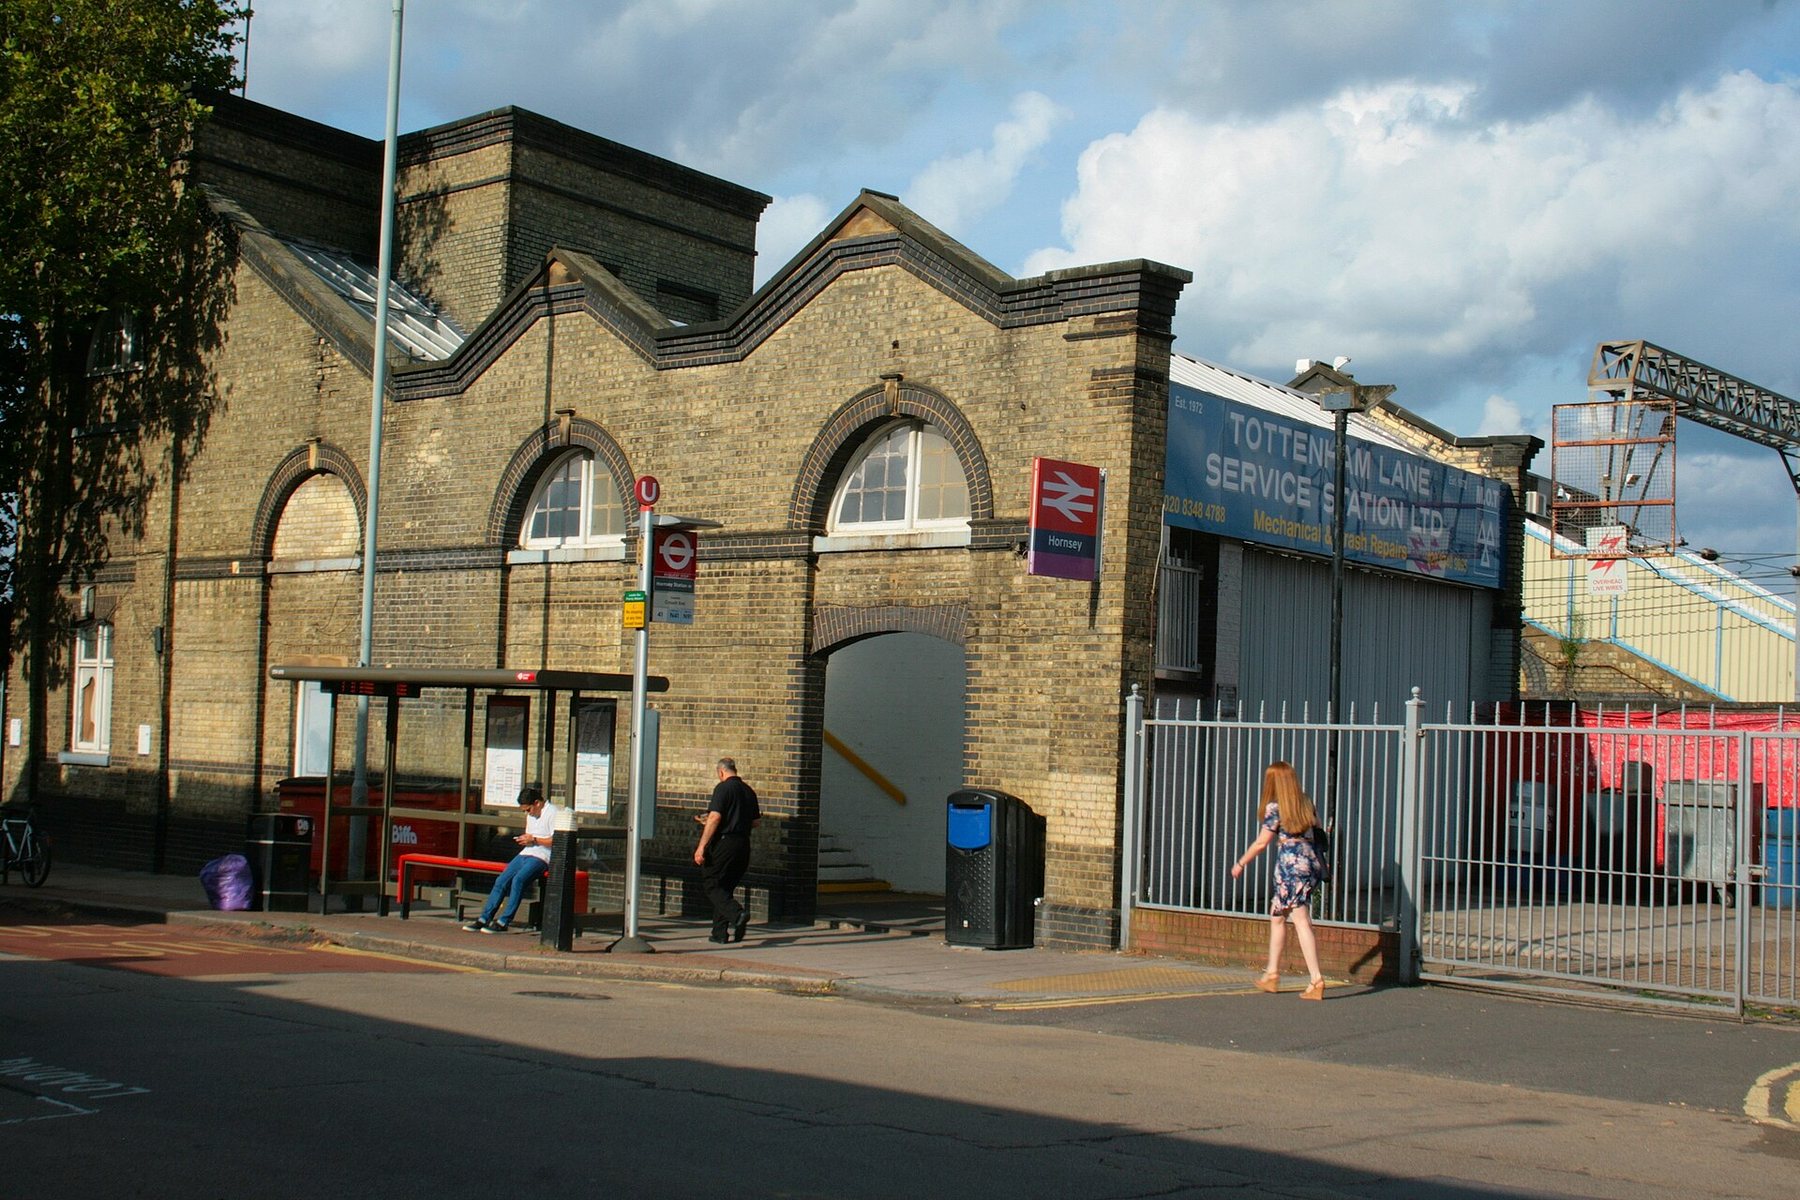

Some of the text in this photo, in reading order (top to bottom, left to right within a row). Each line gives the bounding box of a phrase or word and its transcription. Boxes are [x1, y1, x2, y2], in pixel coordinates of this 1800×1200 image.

[1175, 395, 1203, 414] Est. 1972
[1230, 411, 1430, 496] TOTTENHAM LANE
[642, 482, 657, 501] U
[1205, 453, 1443, 538] SERVICE SATION LTD
[1164, 494, 1226, 523] 020 8348 4788
[1048, 535, 1083, 551] Hornsey
[1253, 509, 1321, 543] Mechanical
[1343, 530, 1366, 549] rash
[1370, 533, 1408, 561] Repairs
[391, 824, 417, 844] Biffa
